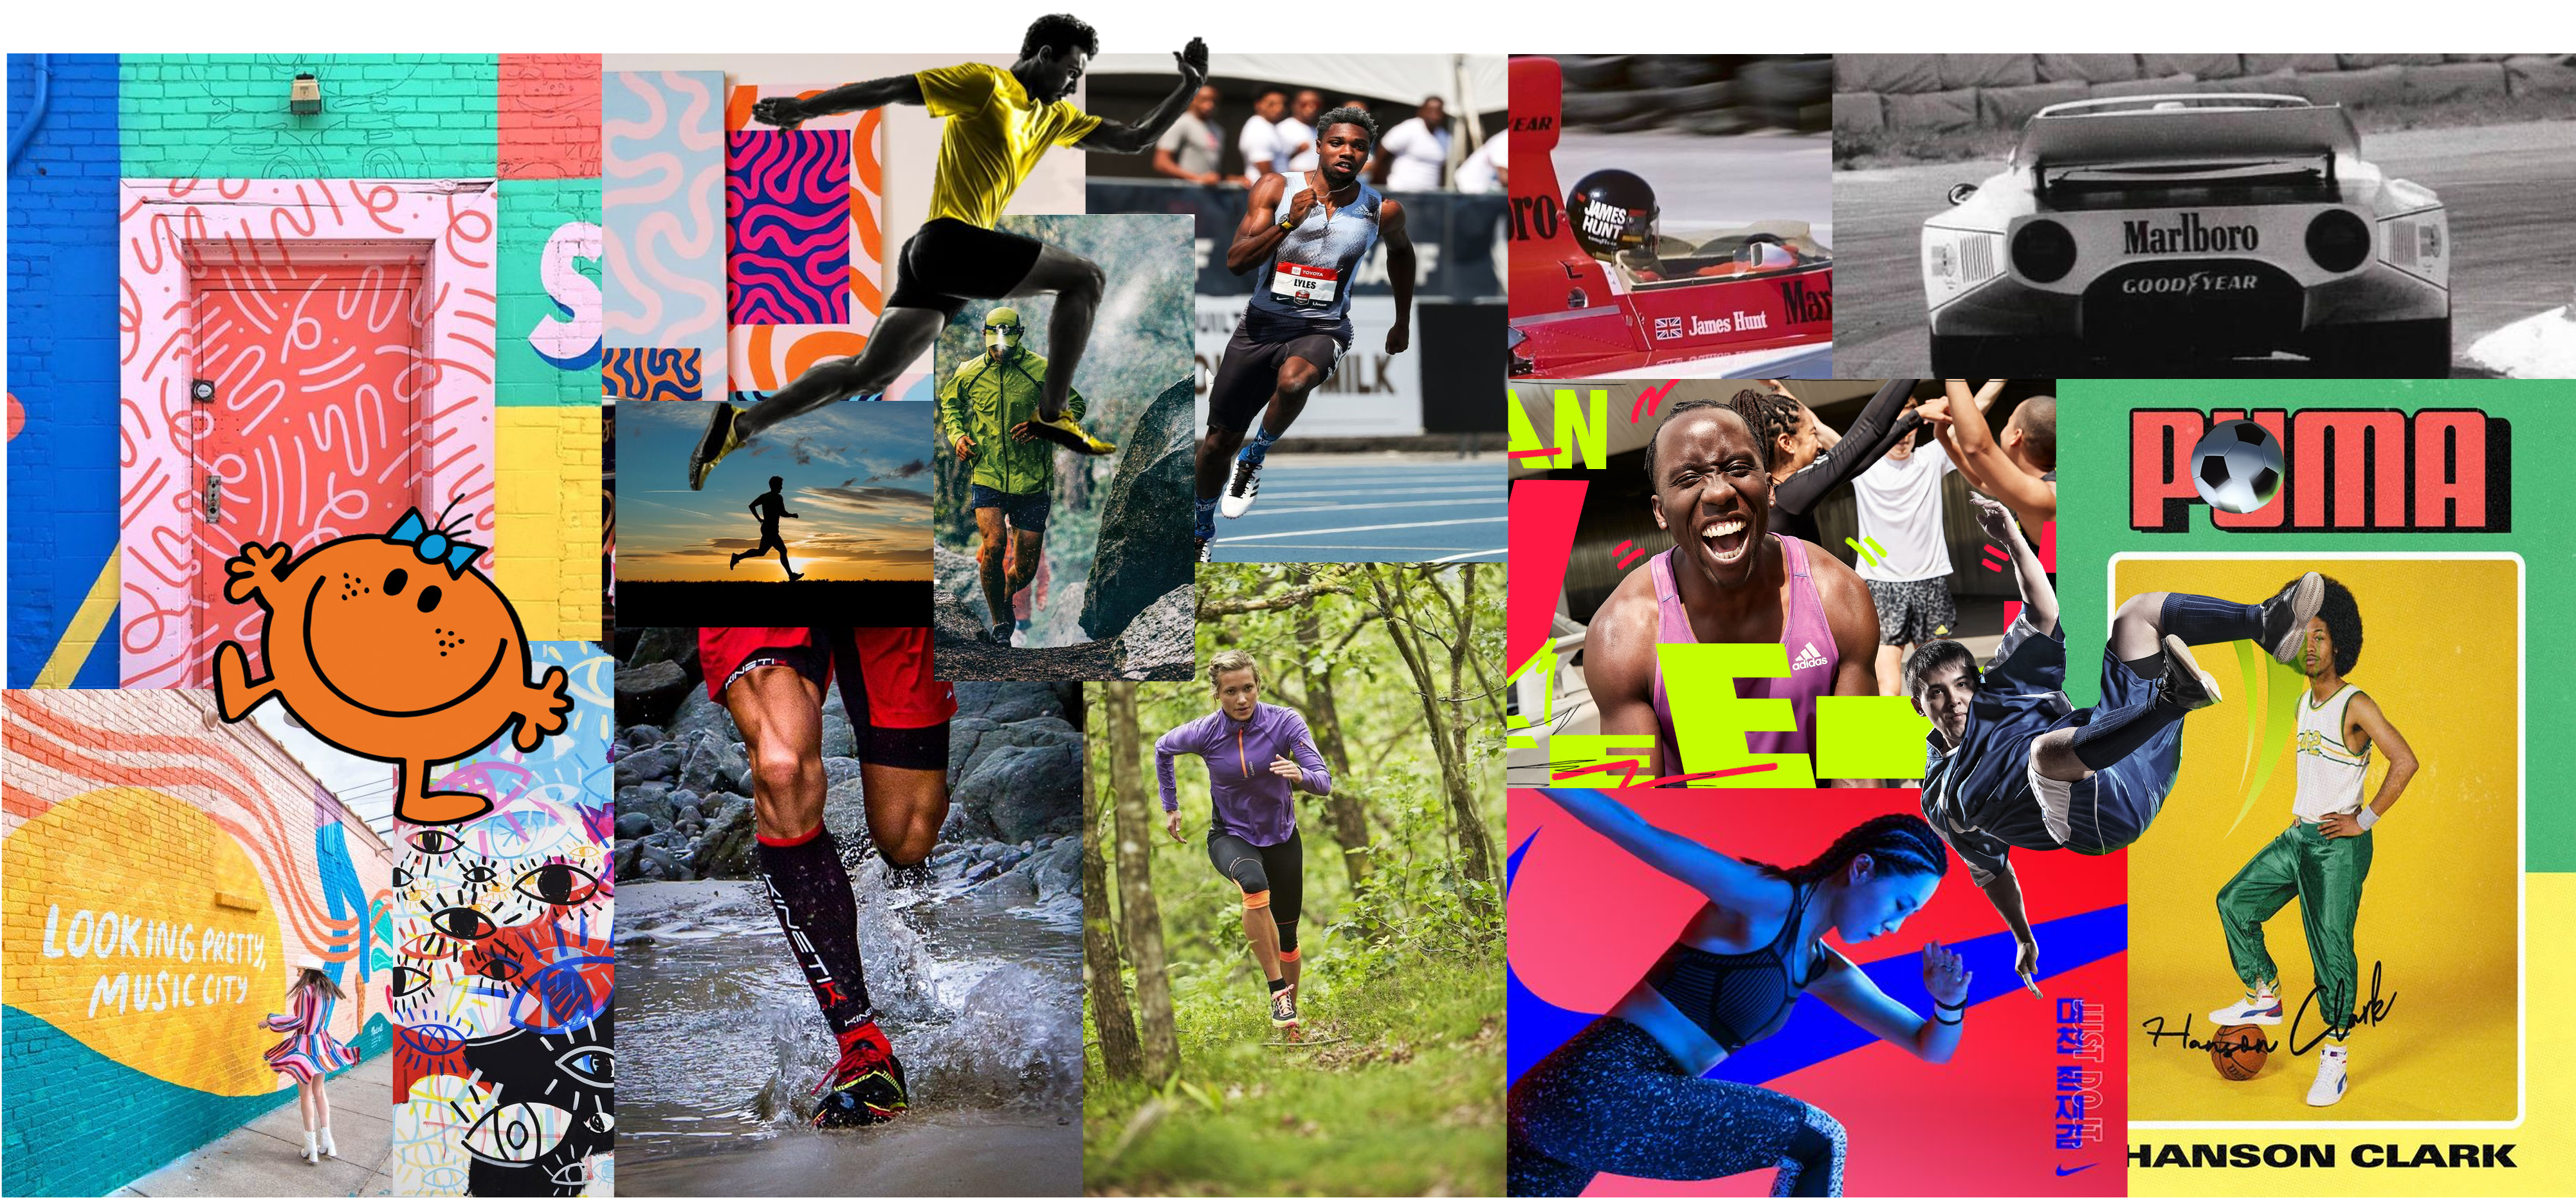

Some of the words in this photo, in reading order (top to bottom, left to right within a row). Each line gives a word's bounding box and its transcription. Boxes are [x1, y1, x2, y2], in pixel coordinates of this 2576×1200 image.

[1508, 116, 1552, 131] EAR
[1584, 199, 1626, 225] JAMES
[1583, 216, 1623, 239] HUNT
[2124, 212, 2259, 254] Marlboro
[1293, 279, 1317, 290] LYLES
[1689, 315, 1731, 337] James
[1733, 311, 1768, 332] Hunt
[725, 658, 788, 690] KINETIK
[1792, 657, 1828, 670] adidas
[2299, 729, 2321, 756] 42
[42, 903, 196, 963] LOOKING
[201, 927, 266, 972] PRETTY,
[763, 873, 847, 1006] KINETIK
[88, 970, 196, 1019] MUSIC
[202, 973, 248, 1005] CITY
[2142, 1013, 2278, 1058] Hanson
[2290, 961, 2397, 1056] Clark
[2072, 999, 2104, 1062] JUST
[2072, 1071, 2103, 1110] DO
[2128, 1144, 2335, 1168] HANSON
[2350, 1144, 2517, 1168] CLARK
